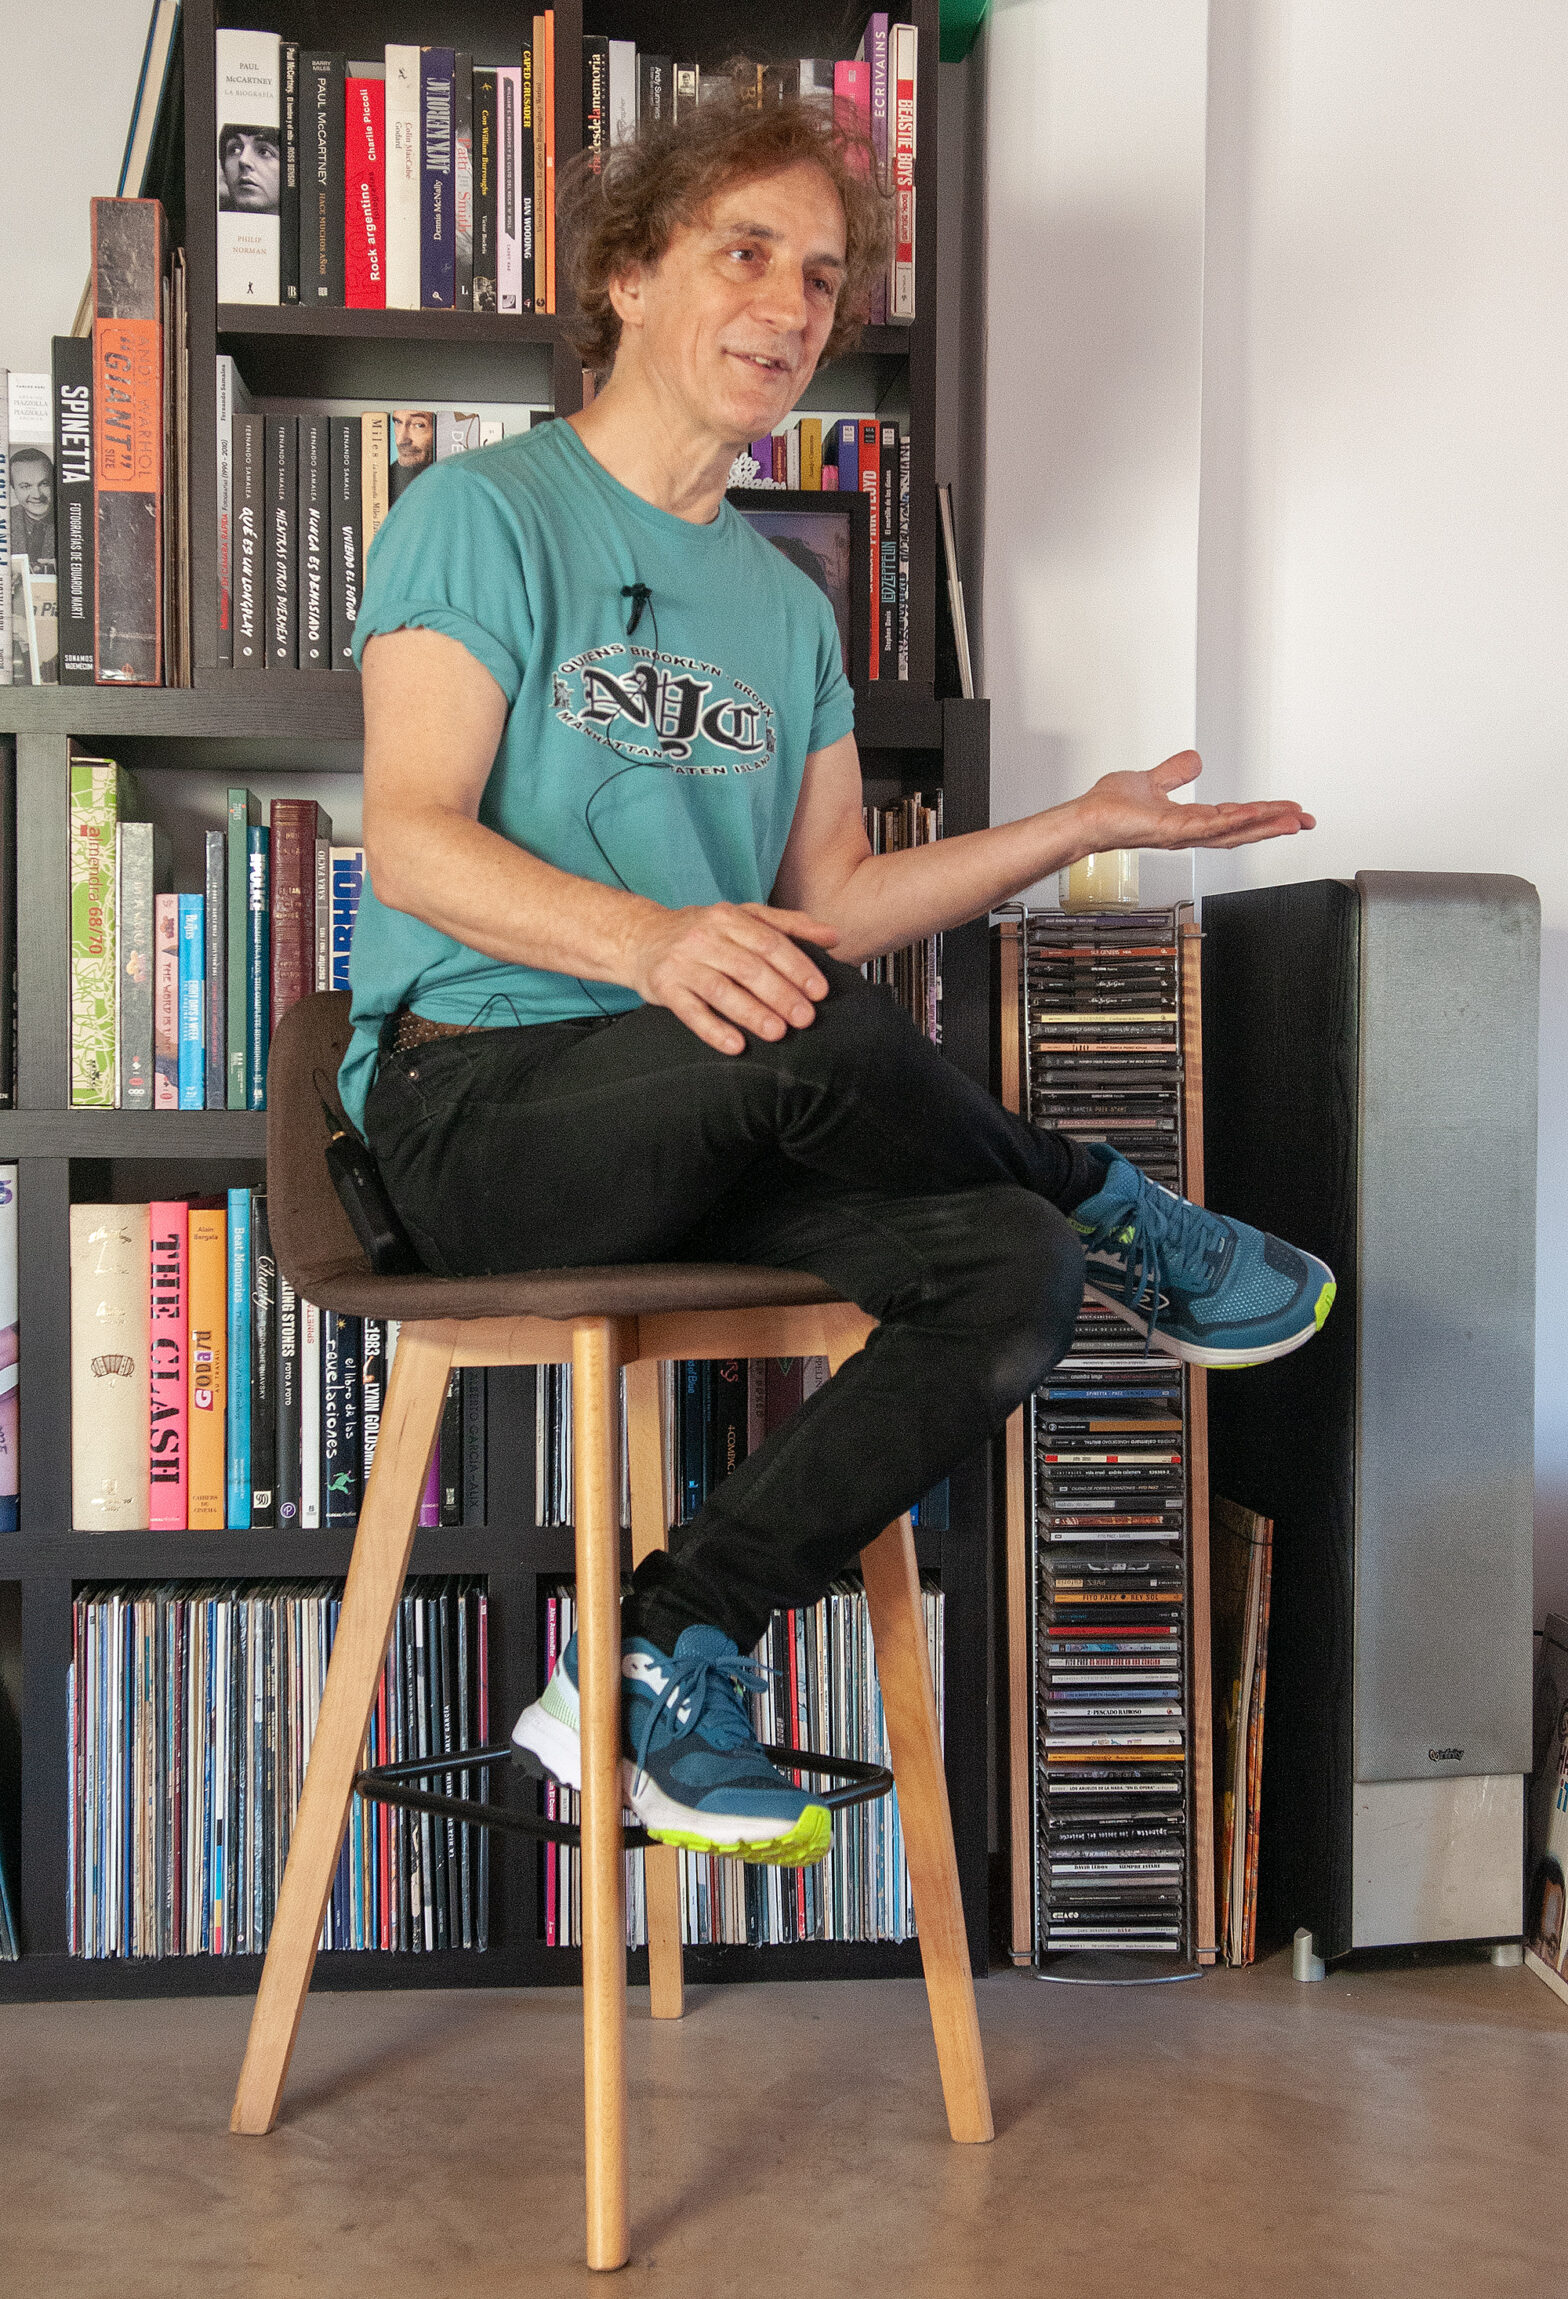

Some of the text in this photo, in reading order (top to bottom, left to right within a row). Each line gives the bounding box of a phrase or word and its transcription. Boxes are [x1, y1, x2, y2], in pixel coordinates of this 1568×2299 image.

[239, 62, 260, 71] PAUL
[286, 48, 294, 60] Paul
[654, 67, 662, 85] Andy
[874, 31, 885, 118] ECRIVAINS
[226, 75, 272, 86] McCARTNEY
[523, 51, 531, 128] CAPED CRUSADER
[318, 78, 326, 186] PAUL McCARTNEY
[360, 89, 376, 161] Charlie Piccoli
[394, 121, 402, 149] Godard
[405, 122, 413, 178] Colin MacCabe
[426, 77, 450, 174] JACK KEROUAC
[898, 100, 912, 186] BEASTIE BOYS
[287, 147, 296, 188] ROSS BENSON
[458, 138, 471, 232] Patti Smith
[360, 183, 381, 281] Rock argentino
[433, 180, 442, 240] Dennis McNally
[524, 198, 532, 259] DAN WOODING
[232, 246, 267, 255] NORMAN
[237, 235, 262, 244] PHILIP
[319, 254, 327, 274] AÑOS
[138, 336, 152, 479] ANDY WARHOL
[61, 385, 91, 484] SPINETTA
[105, 448, 116, 469] SIZE
[372, 419, 382, 457] Miles
[239, 506, 257, 536] QUÉ
[70, 502, 85, 619] FOTOGRAFÍAS DE EDUARDO MARTÍ
[342, 526, 354, 568] VIVIENDO
[276, 508, 287, 644] MIENTRAS OTROS DUERMEN
[308, 508, 320, 641] NUNCA ES DEMASIADO
[346, 571, 355, 582] EL
[240, 578, 253, 637] LONGPLAY
[629, 646, 722, 677] BROOKLYN
[734, 679, 775, 718] BRONX
[556, 710, 665, 759] MANHATTAN
[88, 827, 104, 954] almendra 68/70
[318, 850, 326, 900] SARA FACIO
[163, 963, 171, 981] THE
[318, 955, 326, 980] escritor
[163, 984, 171, 1014] WORD
[189, 1000, 198, 1016] DAYS
[189, 1022, 198, 1041] WEEK
[150, 1234, 180, 1320] THE
[234, 1227, 244, 1303] Beat Memories
[252, 1256, 275, 1310] Charly
[282, 1313, 294, 1357] STONES
[306, 1303, 315, 1344] SPINETTA
[326, 1339, 345, 1459] revelaciones
[345, 1358, 357, 1440] el libro de las
[364, 1383, 379, 1411] LYNN
[469, 1370, 480, 1420] ALBERTO
[687, 1376, 697, 1394] Blue
[150, 1338, 180, 1485] CLASH
